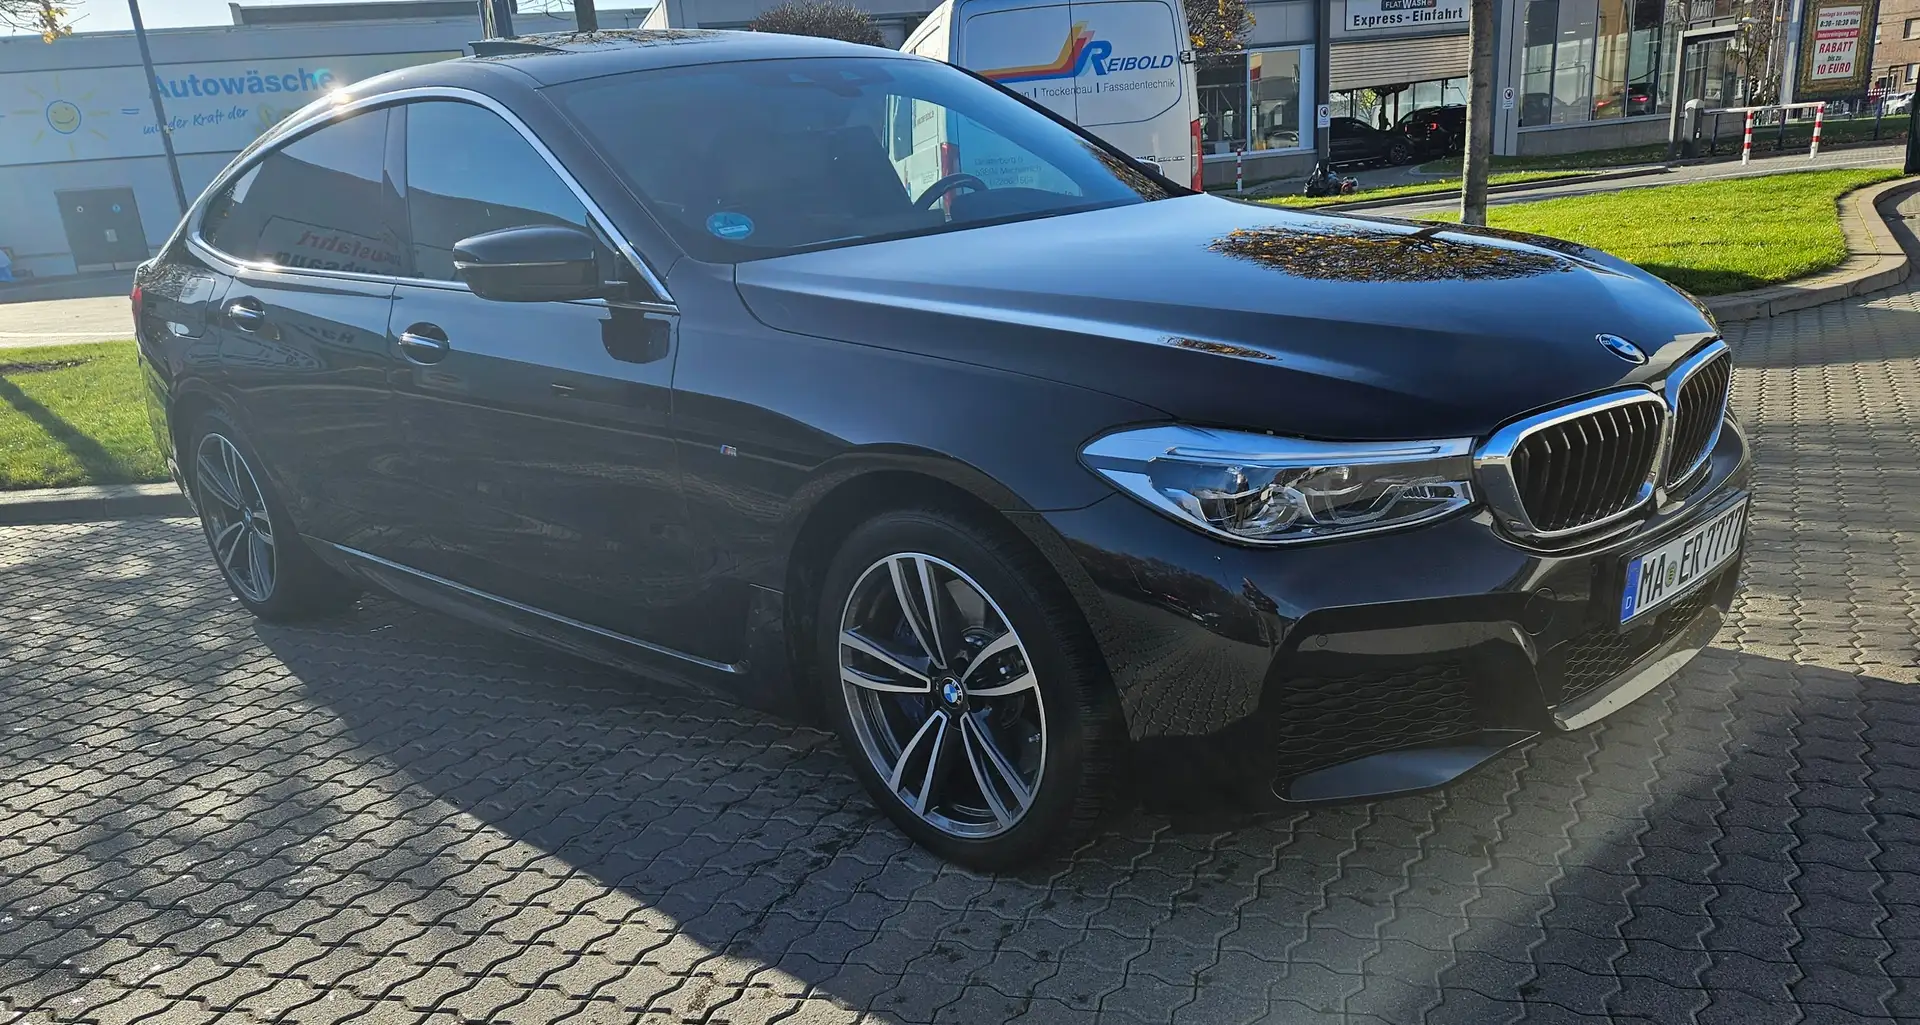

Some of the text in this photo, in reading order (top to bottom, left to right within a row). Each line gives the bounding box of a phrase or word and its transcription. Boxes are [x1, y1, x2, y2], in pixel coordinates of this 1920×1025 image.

[1818, 41, 1853, 54] RABATT
[1075, 40, 1174, 76] REIBOLD
[1816, 62, 1851, 75] 10 EURO
[1041, 86, 1093, 97] Trockenbau
[1103, 79, 1175, 92] Fassadentechnik
[192, 108, 225, 127] Kraft
[228, 105, 249, 120] der
[1636, 552, 1667, 609] MA
[1678, 531, 1704, 585] ER
[1704, 503, 1745, 569] 7777
[1625, 596, 1632, 610] D
